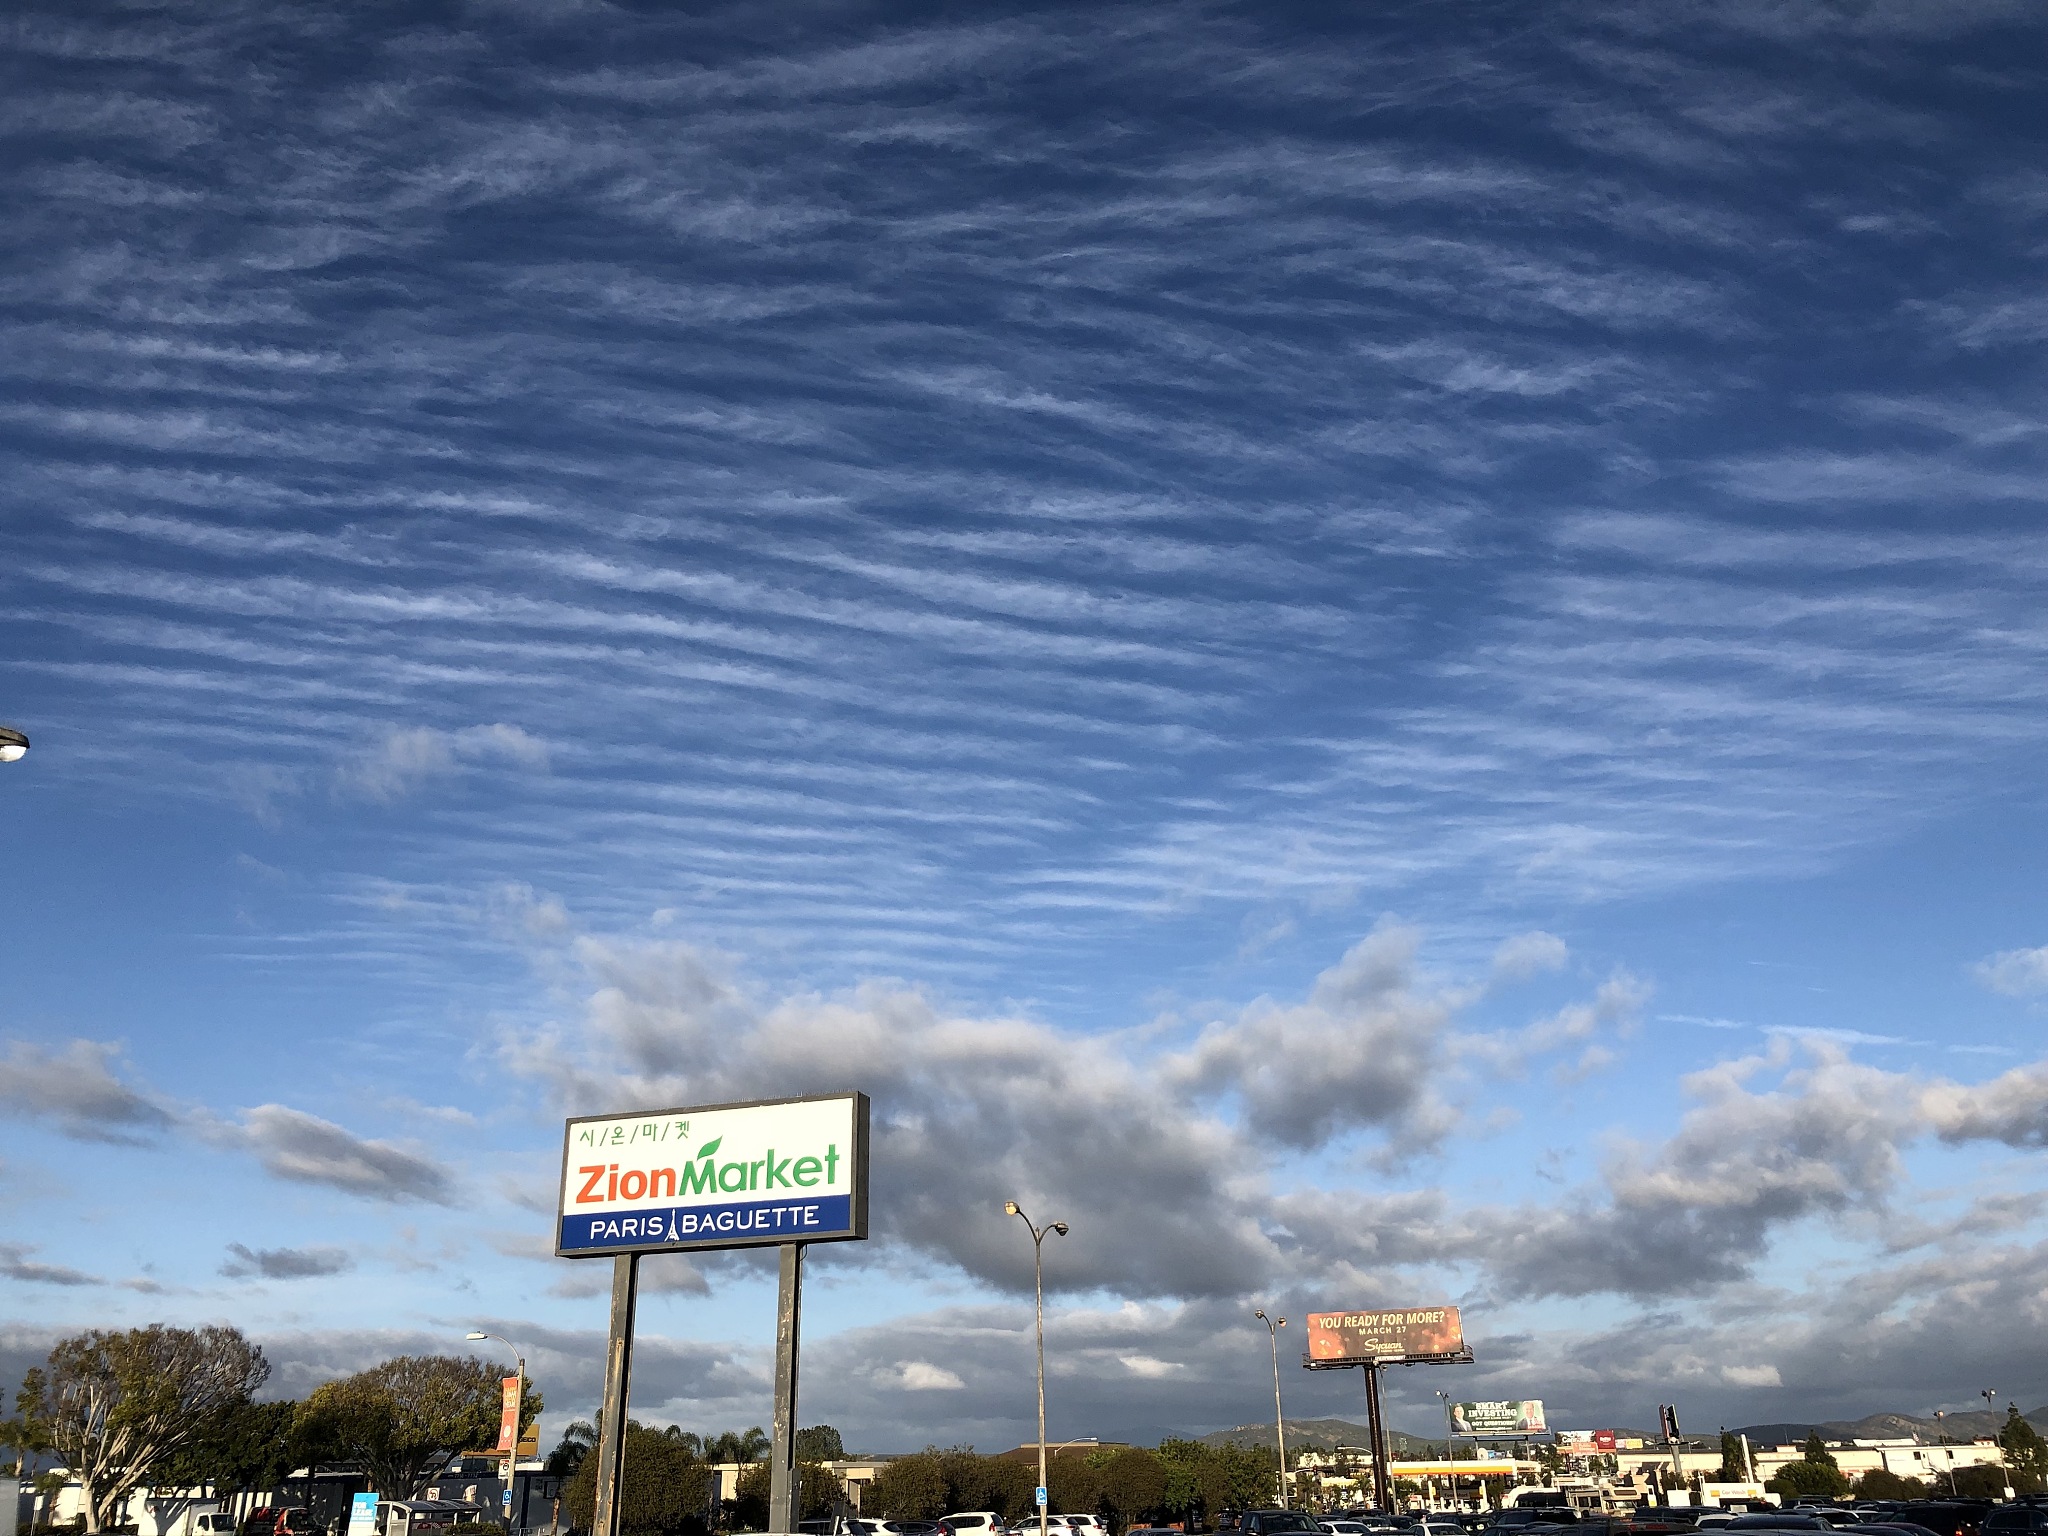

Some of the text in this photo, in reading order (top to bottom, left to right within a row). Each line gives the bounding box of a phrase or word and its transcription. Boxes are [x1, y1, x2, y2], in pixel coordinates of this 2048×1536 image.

[590, 1205, 820, 1240] PARIS BAGUETTE
[1319, 1310, 1445, 1329] YOU READY FOR MORE?
[1358, 1325, 1407, 1336] MARCH 27
[1364, 1337, 1404, 1354] Sycuan
[1475, 1400, 1509, 1410] SMART
[1468, 1408, 1518, 1418] INVESTING
[353, 1501, 367, 1509] FOR
[352, 1508, 374, 1516] LEASE
